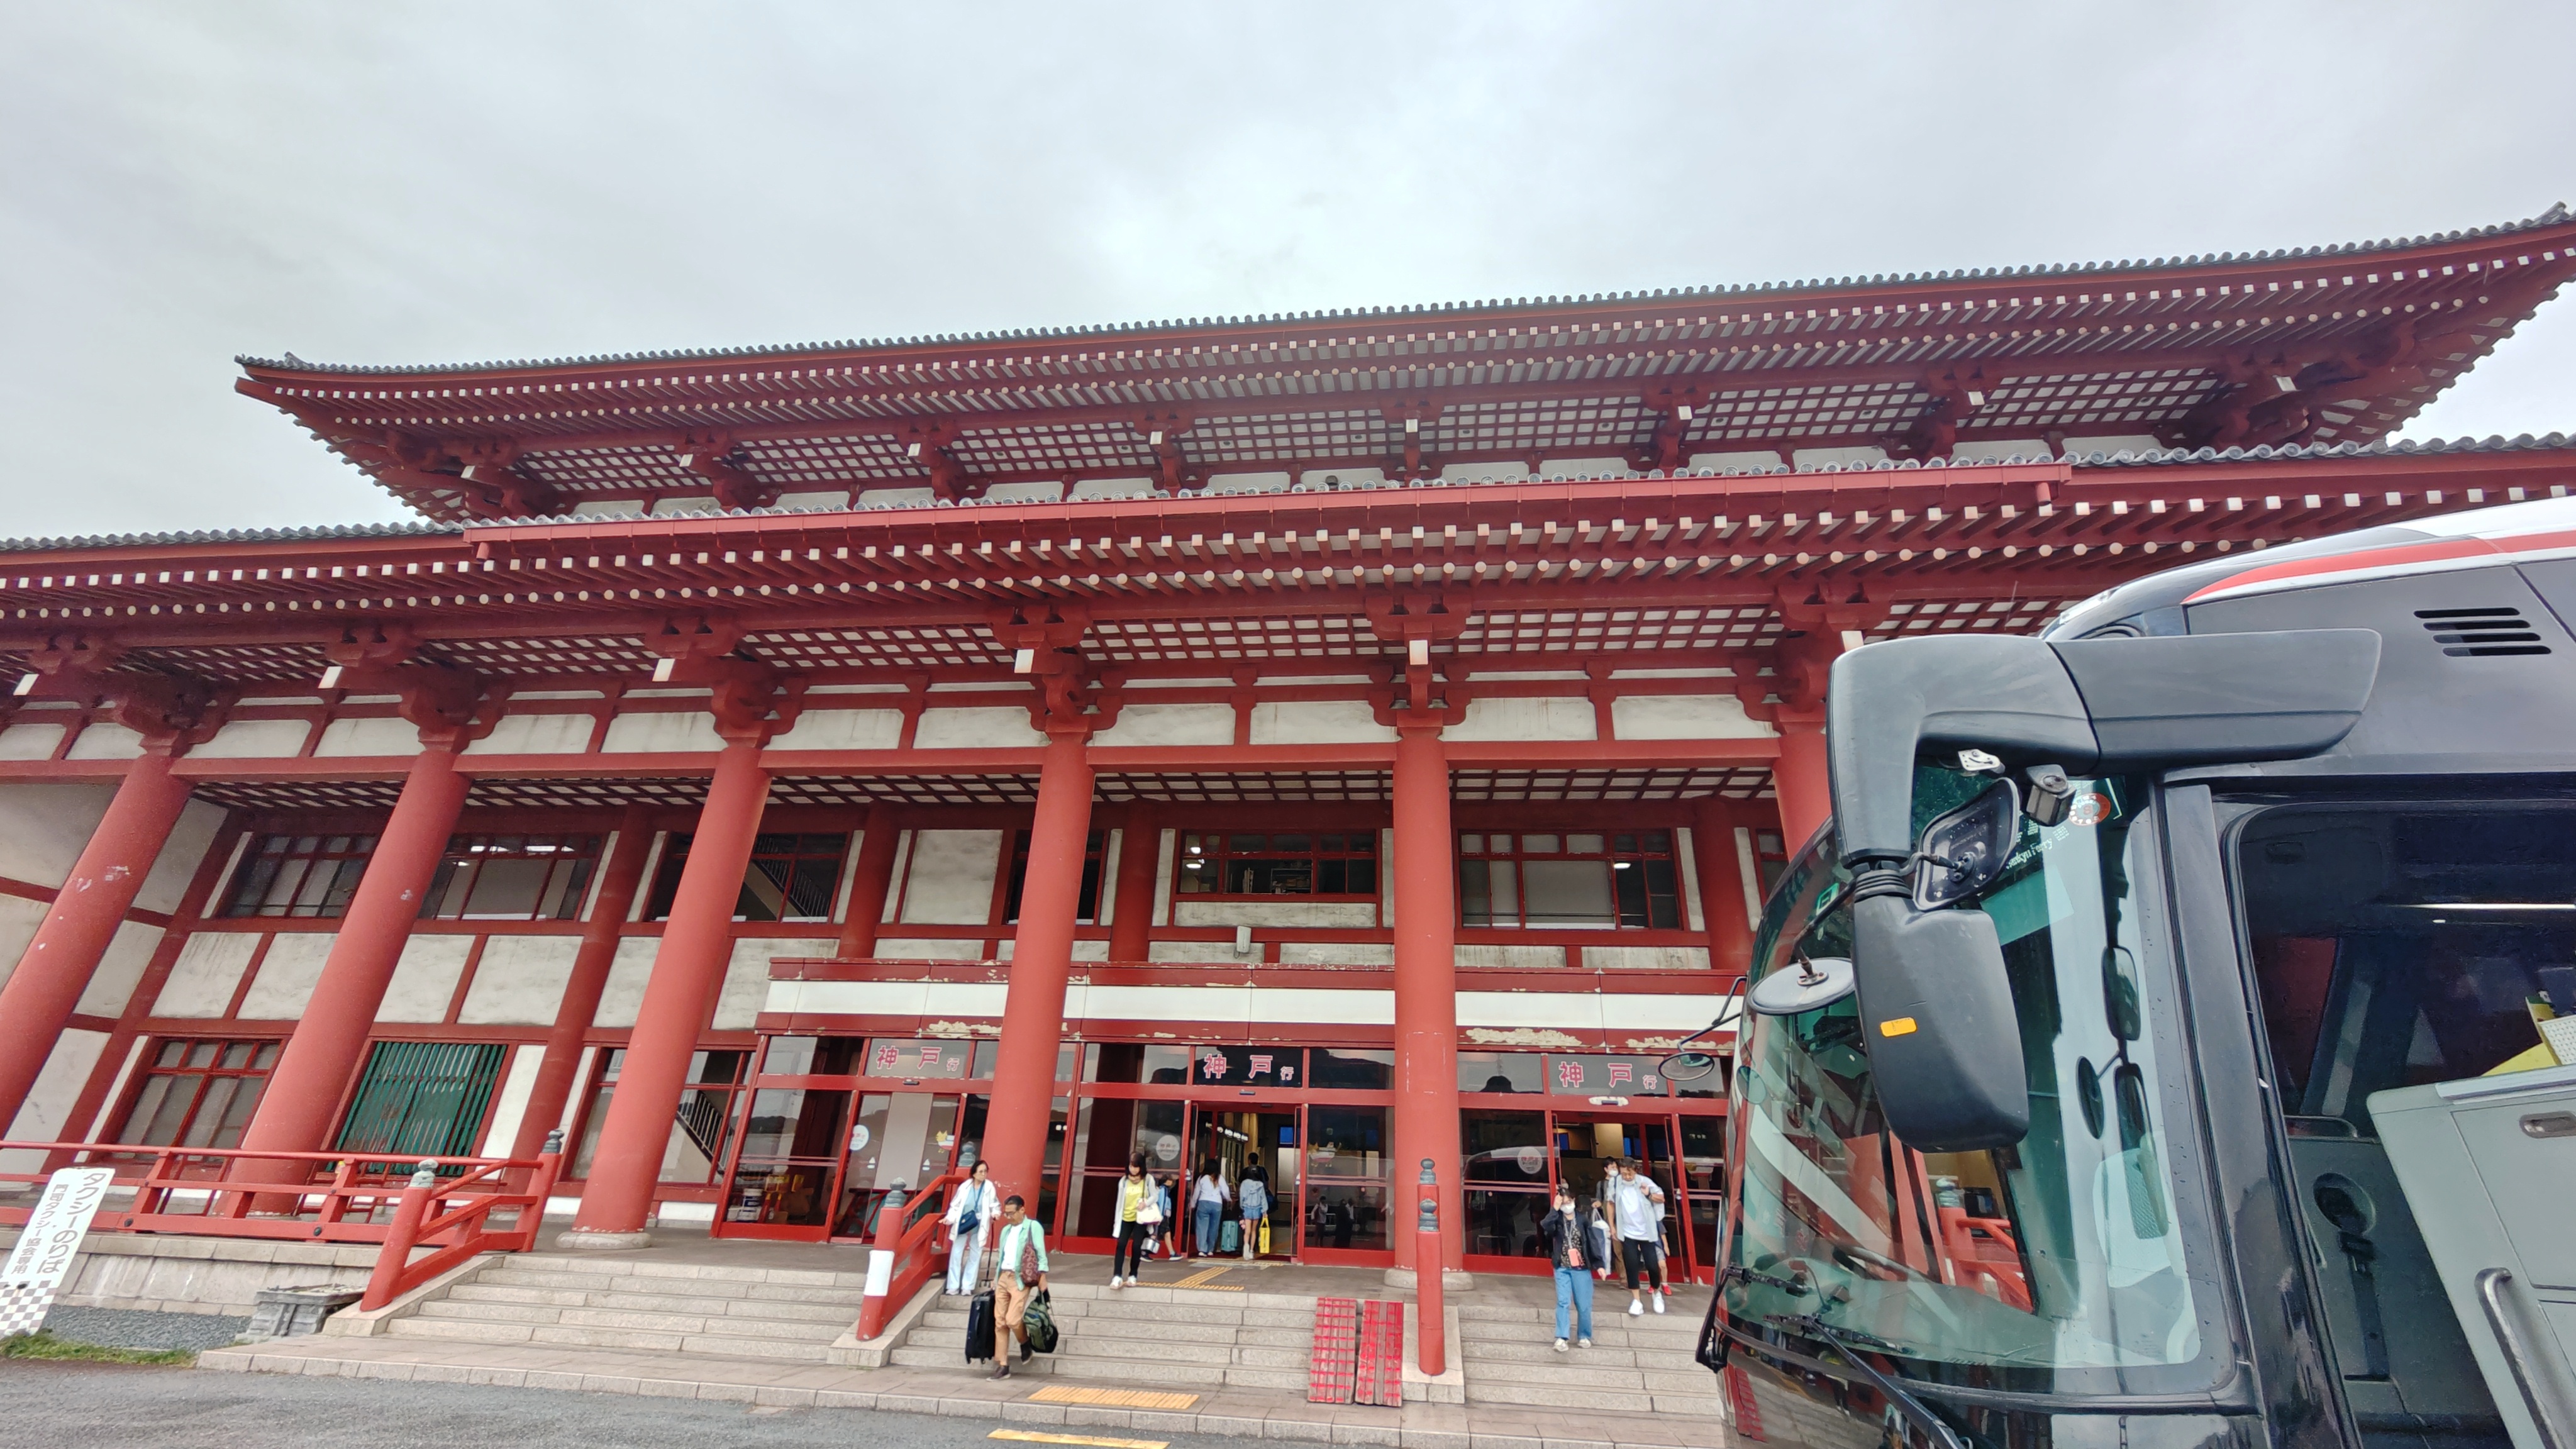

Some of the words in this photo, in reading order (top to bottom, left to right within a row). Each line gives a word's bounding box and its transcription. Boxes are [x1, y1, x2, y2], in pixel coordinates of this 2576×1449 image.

[2029, 838, 2053, 856] Ferry
[36, 1173, 106, 1274] タクシーのりば
